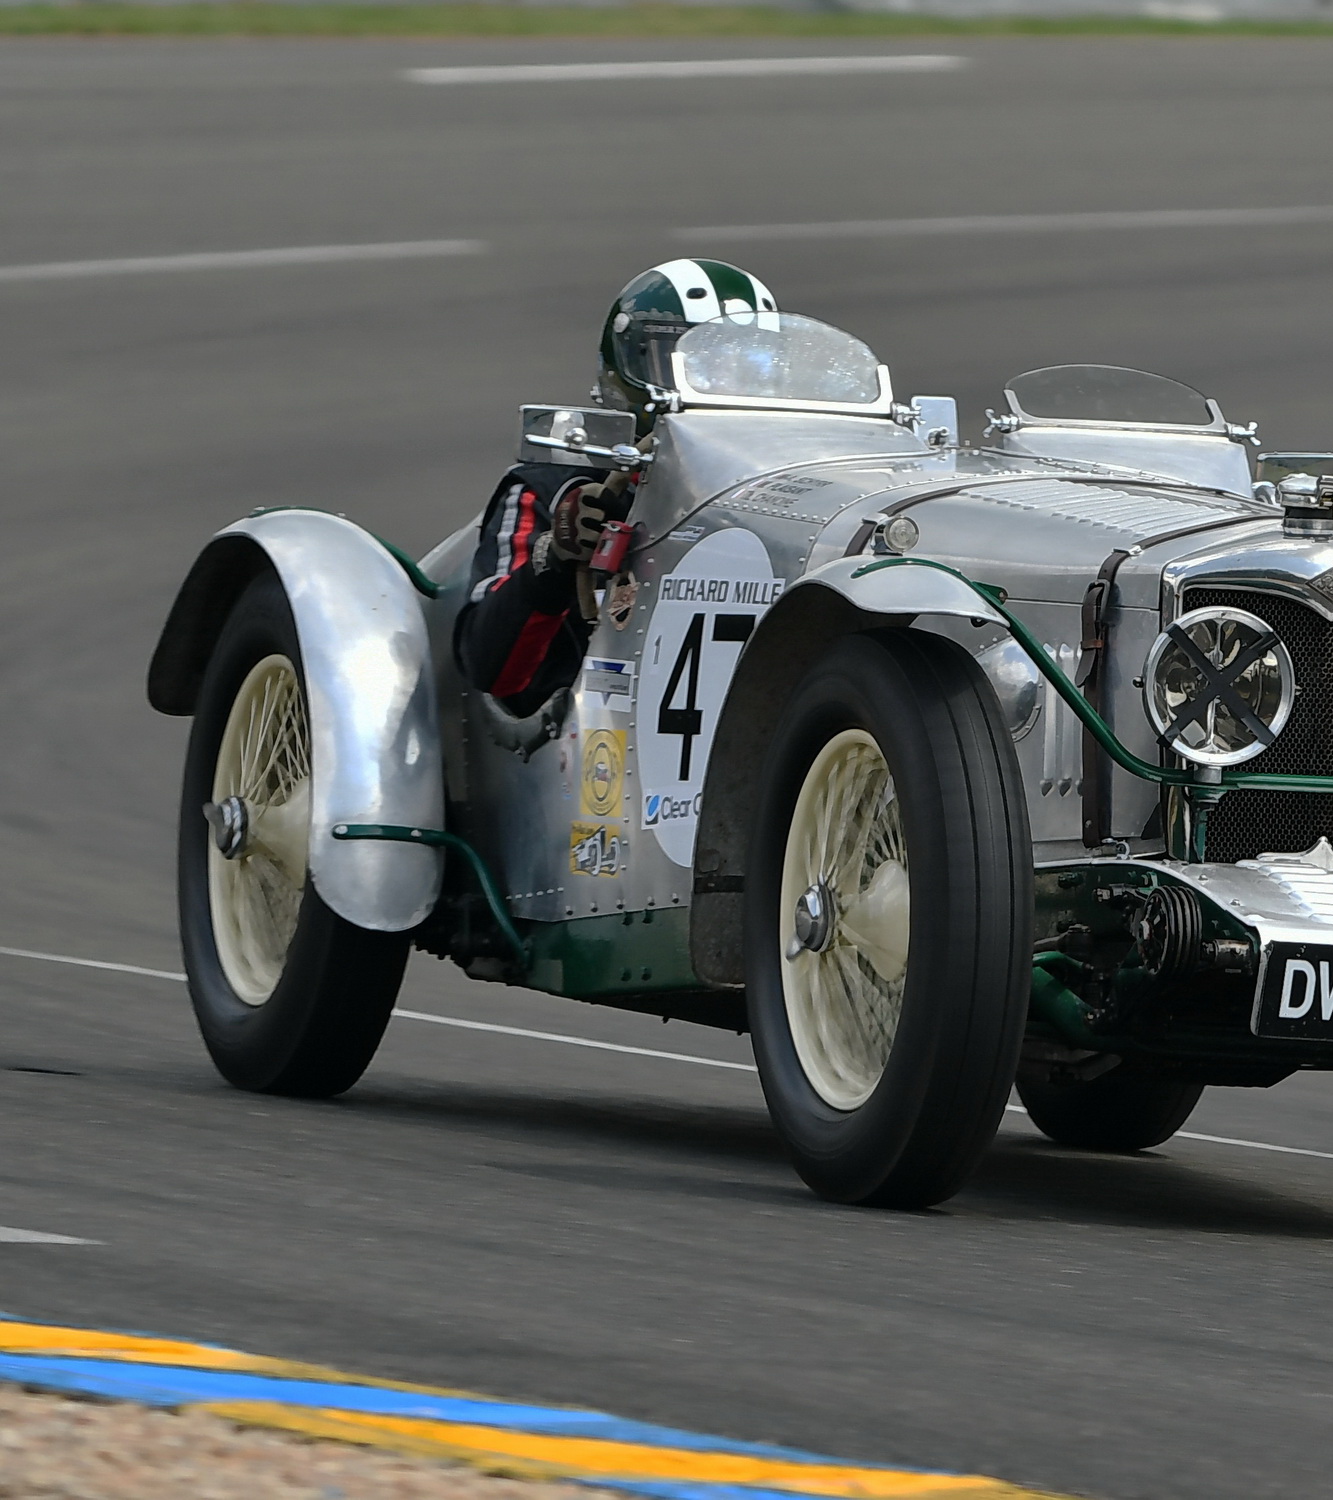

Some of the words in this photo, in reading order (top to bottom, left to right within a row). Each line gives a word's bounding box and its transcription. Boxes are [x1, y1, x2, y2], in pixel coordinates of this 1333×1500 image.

[661, 578, 730, 603] RICHARD
[732, 580, 782, 605] MILLE
[661, 795, 692, 820] Clear
